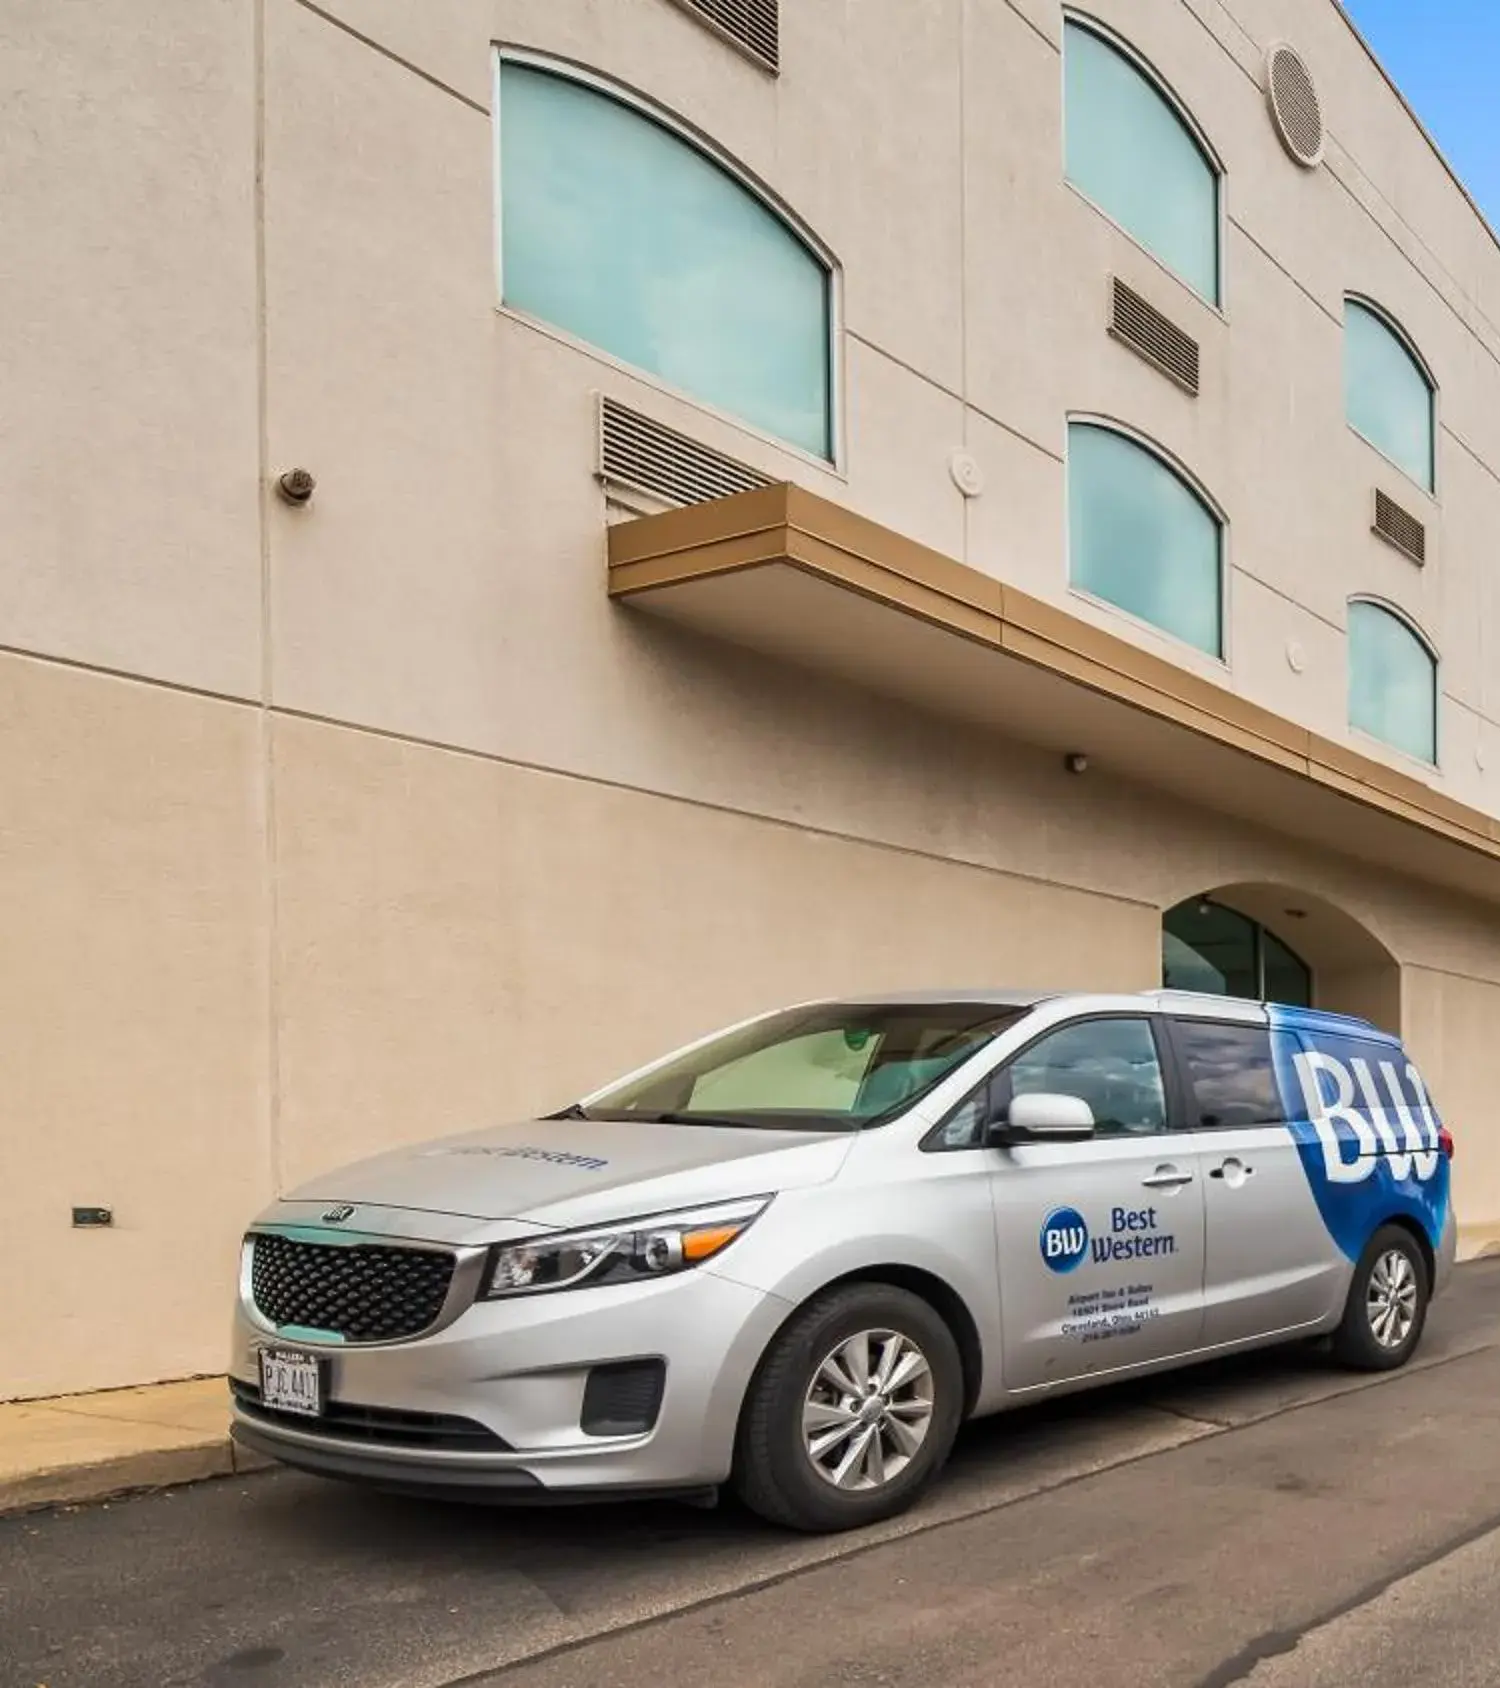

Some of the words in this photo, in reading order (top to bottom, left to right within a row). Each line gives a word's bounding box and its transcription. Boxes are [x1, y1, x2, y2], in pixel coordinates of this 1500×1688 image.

[1291, 1052, 1440, 1183] BW
[1112, 1206, 1156, 1233] Best
[1047, 1226, 1084, 1257] BW
[1091, 1234, 1176, 1264] Western
